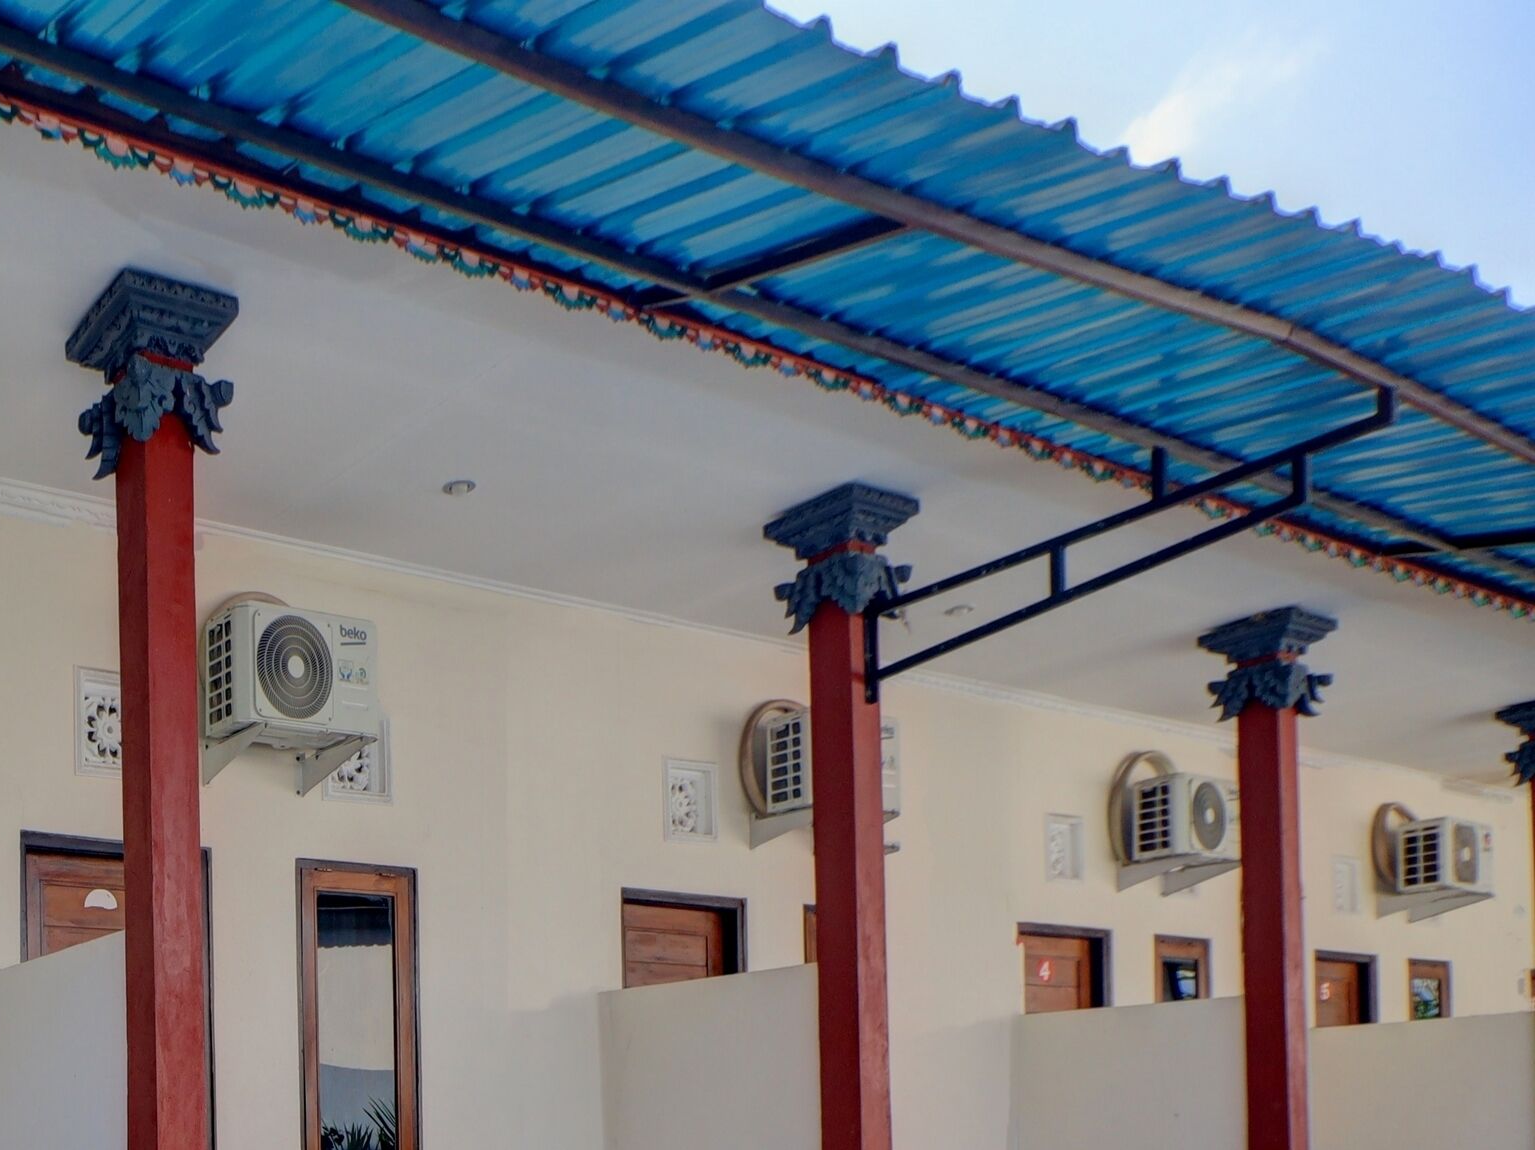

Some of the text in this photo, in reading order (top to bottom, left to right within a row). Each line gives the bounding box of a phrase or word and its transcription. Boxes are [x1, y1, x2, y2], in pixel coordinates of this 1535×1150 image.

[339, 624, 368, 641] beko
[1039, 960, 1051, 981] 4
[1319, 982, 1331, 1001] 5
